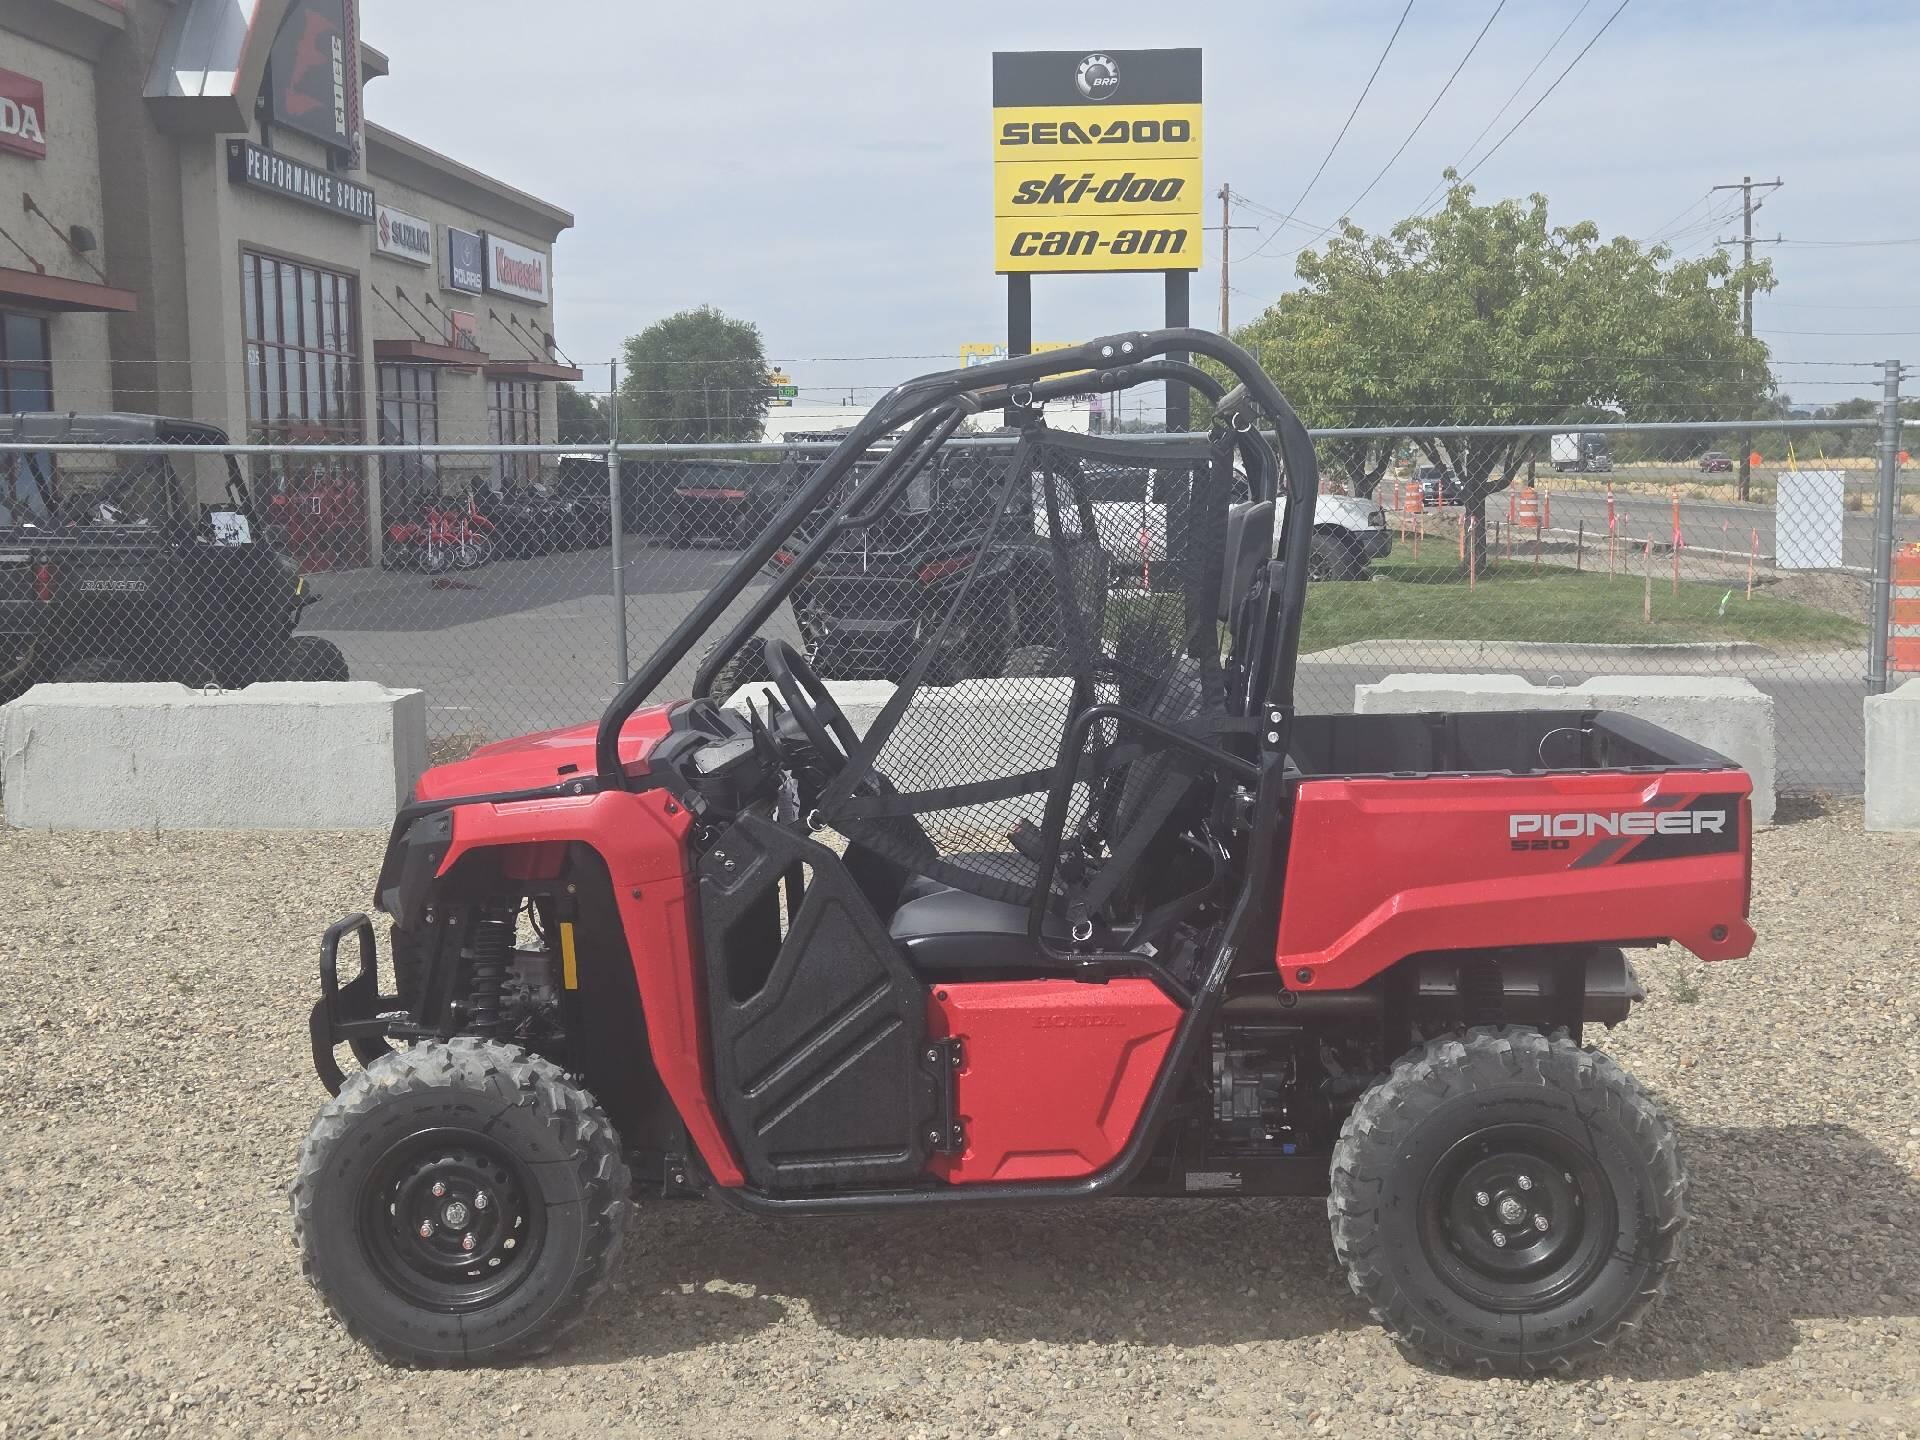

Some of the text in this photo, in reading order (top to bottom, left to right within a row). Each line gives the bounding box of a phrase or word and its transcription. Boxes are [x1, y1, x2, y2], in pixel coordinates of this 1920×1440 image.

[1093, 77, 1118, 86] BRP
[248, 148, 373, 217] PERFORMANCE SPORTS
[1012, 173, 1185, 204] ski-doo
[391, 220, 430, 256] SUZUKI
[1010, 229, 1187, 256] can-am
[453, 267, 482, 288] POLARIS
[495, 246, 543, 294] Kawasaki
[80, 580, 147, 592] RANGER
[1509, 810, 1726, 838] PIONEER
[1511, 839, 1570, 851] 520
